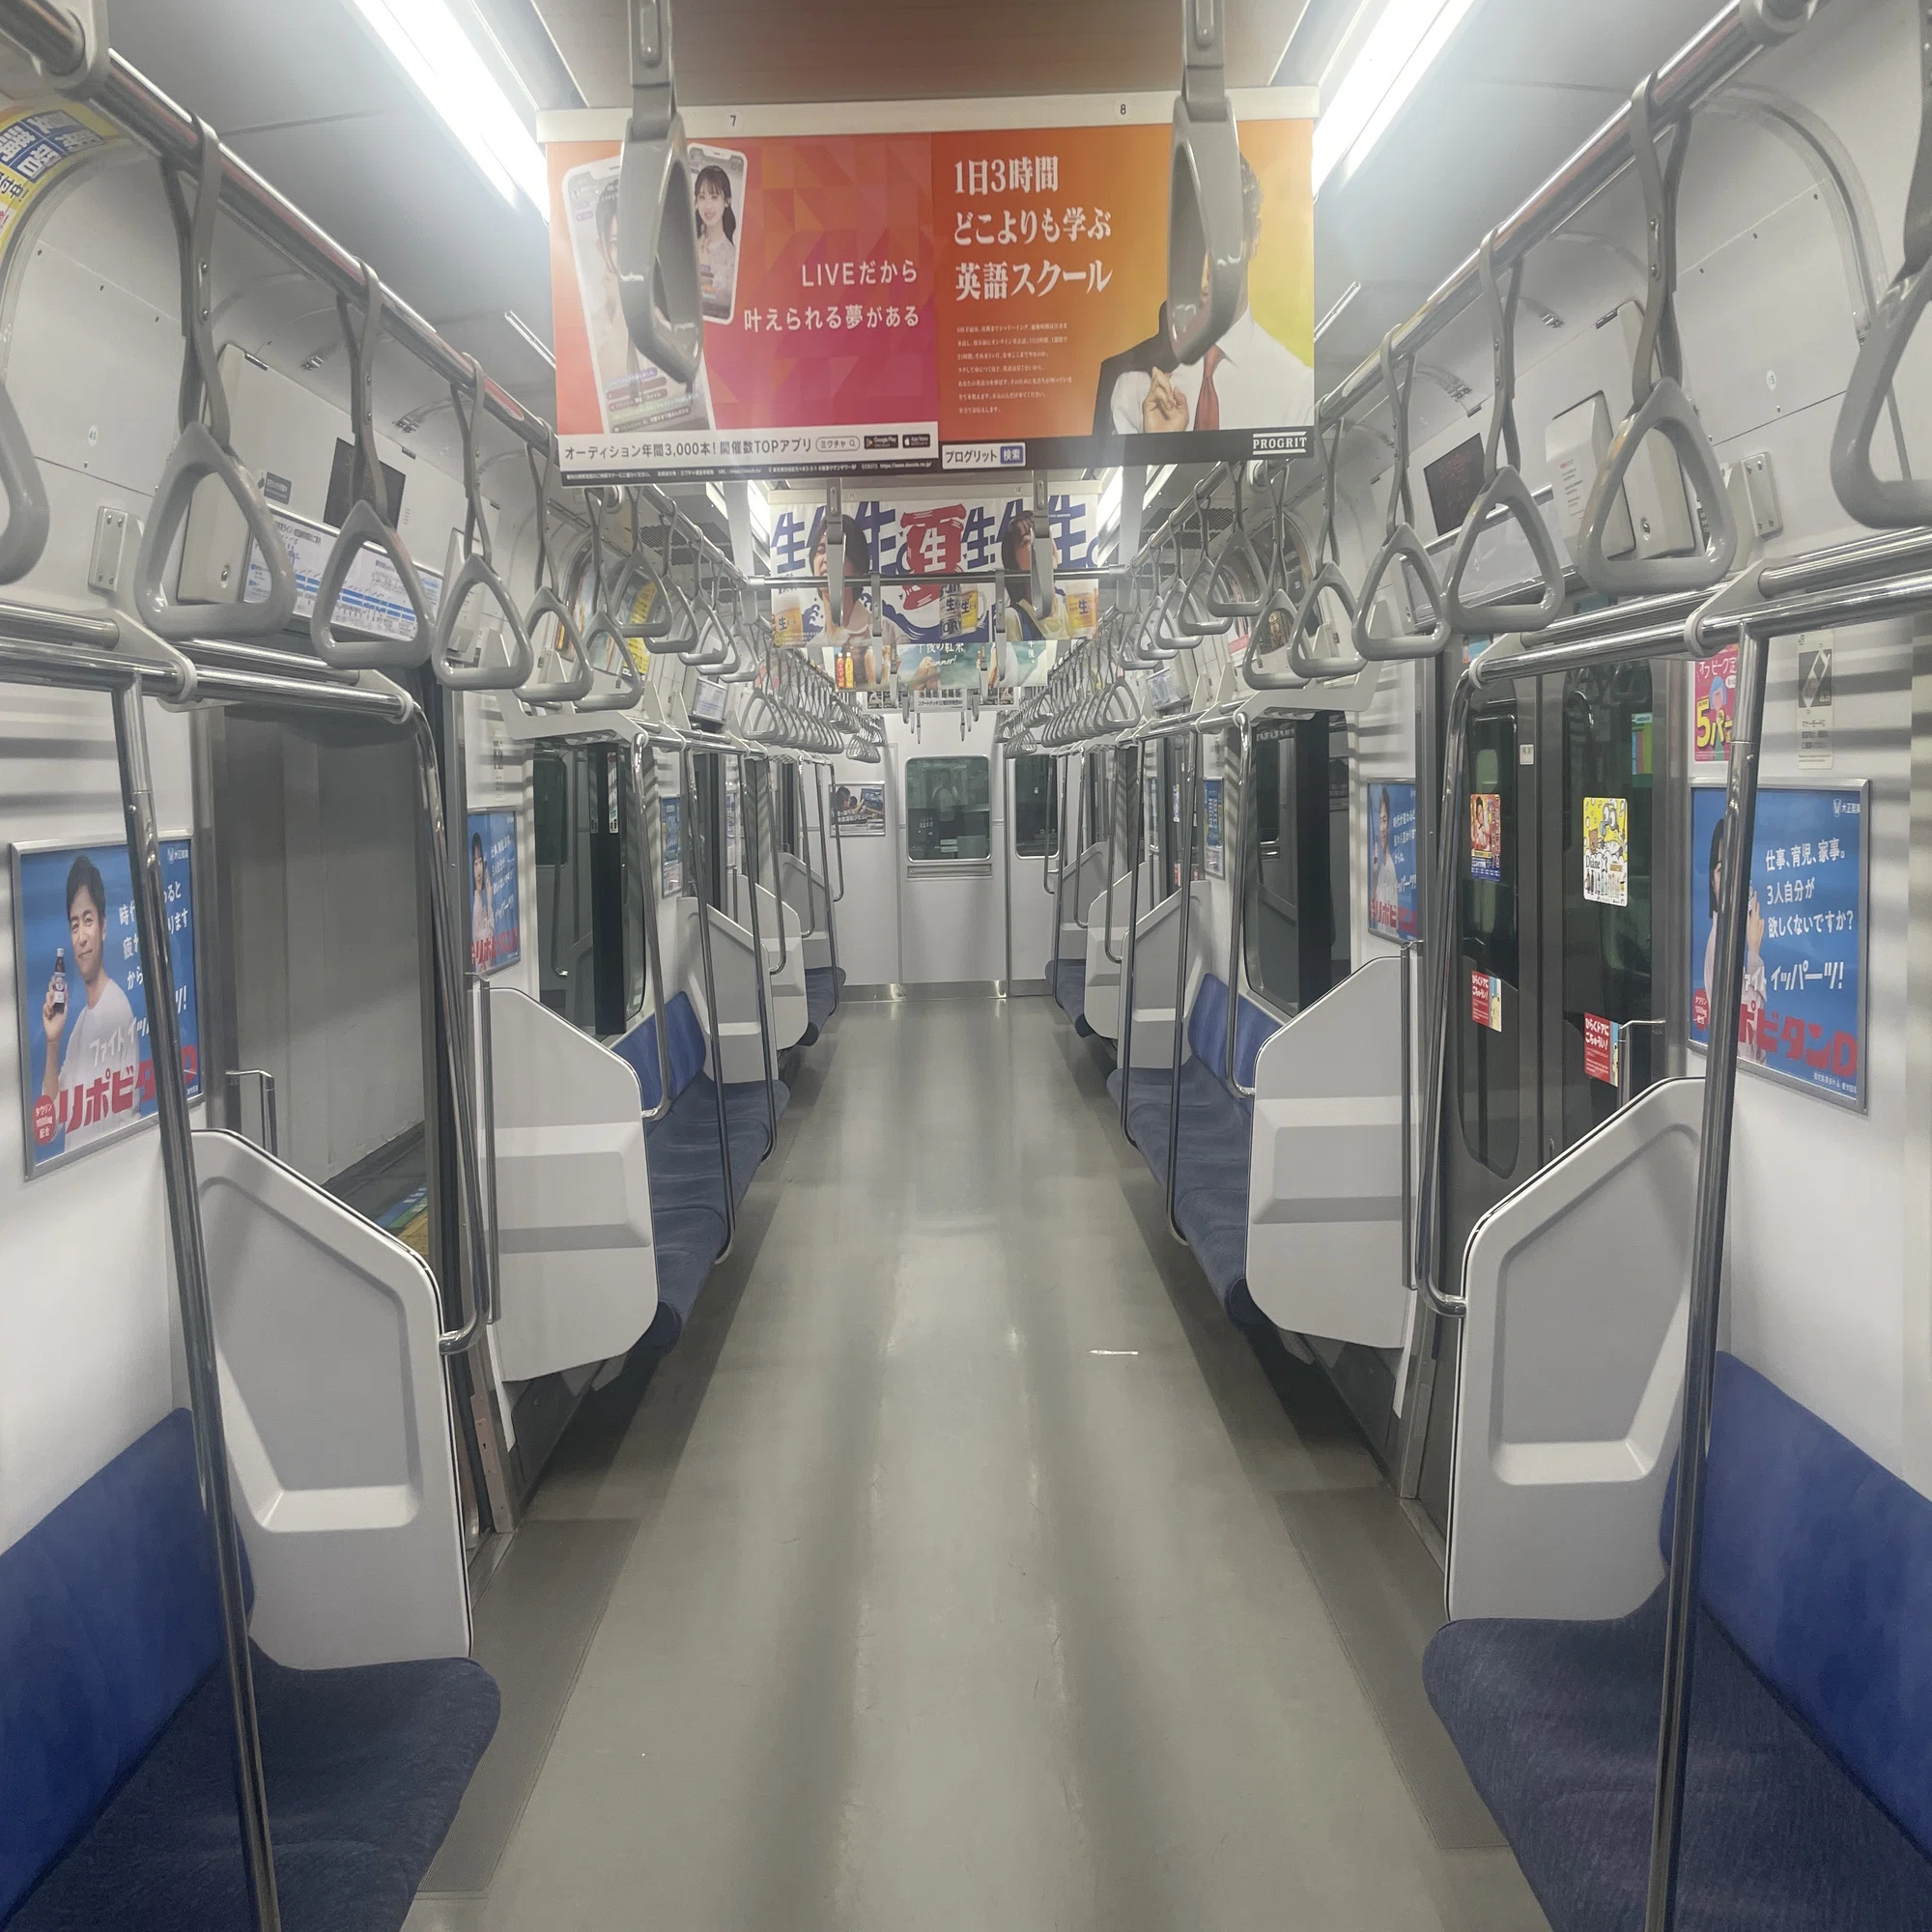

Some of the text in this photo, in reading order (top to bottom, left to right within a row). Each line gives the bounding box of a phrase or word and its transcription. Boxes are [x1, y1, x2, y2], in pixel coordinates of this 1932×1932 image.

[730, 115, 737, 128] 7
[1120, 103, 1126, 115] 8
[954, 156, 1059, 195] 1日3時間
[954, 207, 1111, 245] どこよりも学ぶ
[802, 259, 918, 287] LIVEだから
[955, 260, 1113, 301] 英語スクール
[744, 305, 920, 333] 叶えられる夢がある
[565, 438, 811, 460] オーディション年間3,000本! 開催数TOPアプリ
[945, 448, 998, 465] プログリット
[1002, 446, 1021, 464] 検索
[1253, 437, 1307, 450] PROGRIT
[770, 513, 806, 574] 生
[920, 527, 946, 572] 生
[961, 506, 995, 570] 生
[1765, 838, 1847, 873] 仕事、育児、家事。
[1767, 878, 1816, 907] 3人自分が
[1768, 908, 1853, 939] 欲しくないですか?
[1770, 960, 1845, 992] イッパーツ!
[90, 1031, 126, 1066] ファイト
[1739, 1000, 1858, 1078] ポビタンD
[35, 1104, 52, 1116] タウリン
